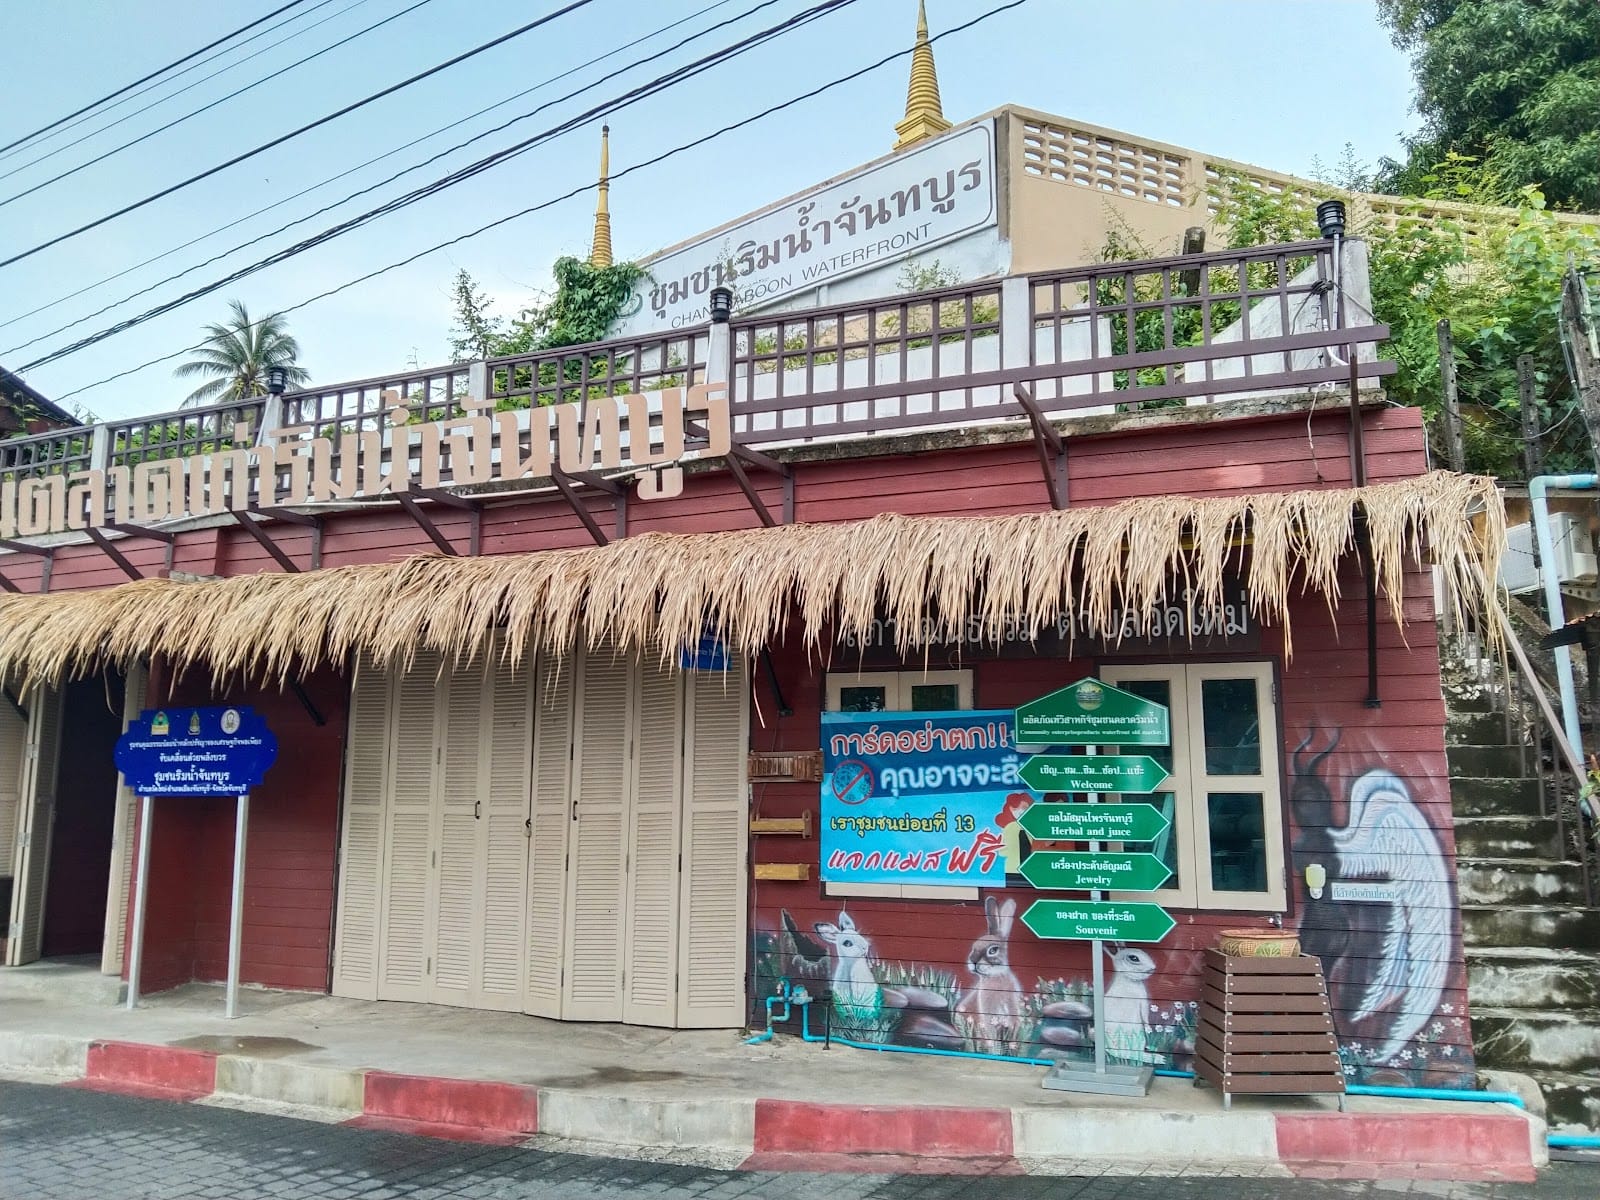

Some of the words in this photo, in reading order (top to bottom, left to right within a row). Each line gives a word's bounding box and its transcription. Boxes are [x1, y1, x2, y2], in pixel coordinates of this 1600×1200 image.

[648, 159, 982, 319] ชุมชนริมน้ำจันทบูร
[671, 275, 792, 329] CHANABOON
[802, 222, 932, 279] WATERFRONT
[830, 720, 1009, 756] การ์ดอย่าตก!!
[154, 765, 231, 786] ชุมชนริมน้ำจันทบูร
[1070, 779, 1114, 789] Welcome
[830, 807, 947, 838] เราชุมชนย่อยที่
[955, 814, 975, 833] 13
[1051, 827, 1083, 836] Herbal
[1086, 827, 1105, 836] and
[1107, 827, 1131, 837] juice
[1075, 874, 1112, 886] Jewelry
[1056, 910, 1089, 920] ของฝาก
[1092, 908, 1136, 922] ของที่ระลึก
[1075, 924, 1119, 936] Souvenir
